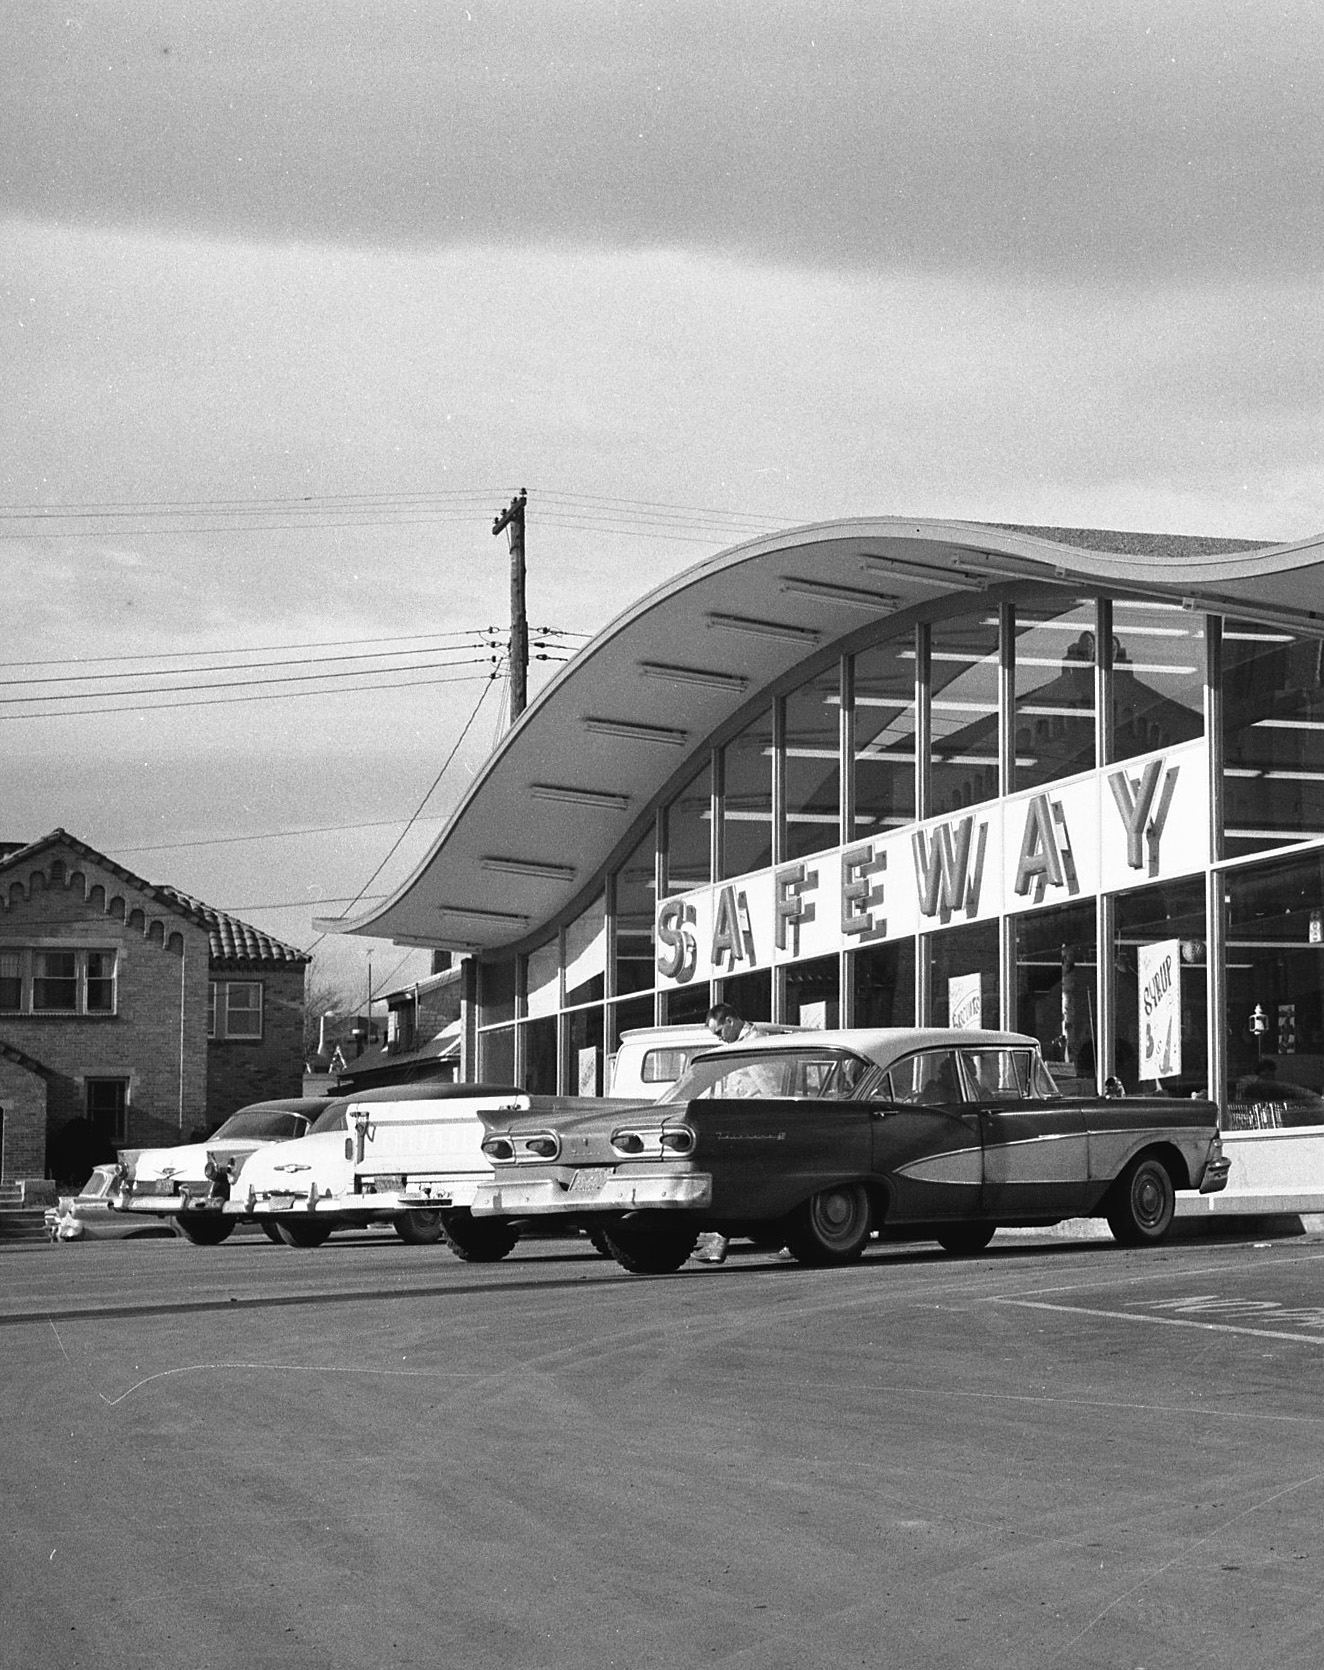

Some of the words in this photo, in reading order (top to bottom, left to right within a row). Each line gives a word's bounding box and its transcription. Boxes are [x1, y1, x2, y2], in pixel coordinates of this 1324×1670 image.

[658, 758, 1168, 978] SAFEWAY
[1143, 954, 1172, 1016] SYRUP
[1125, 1295, 1283, 1313] NO
